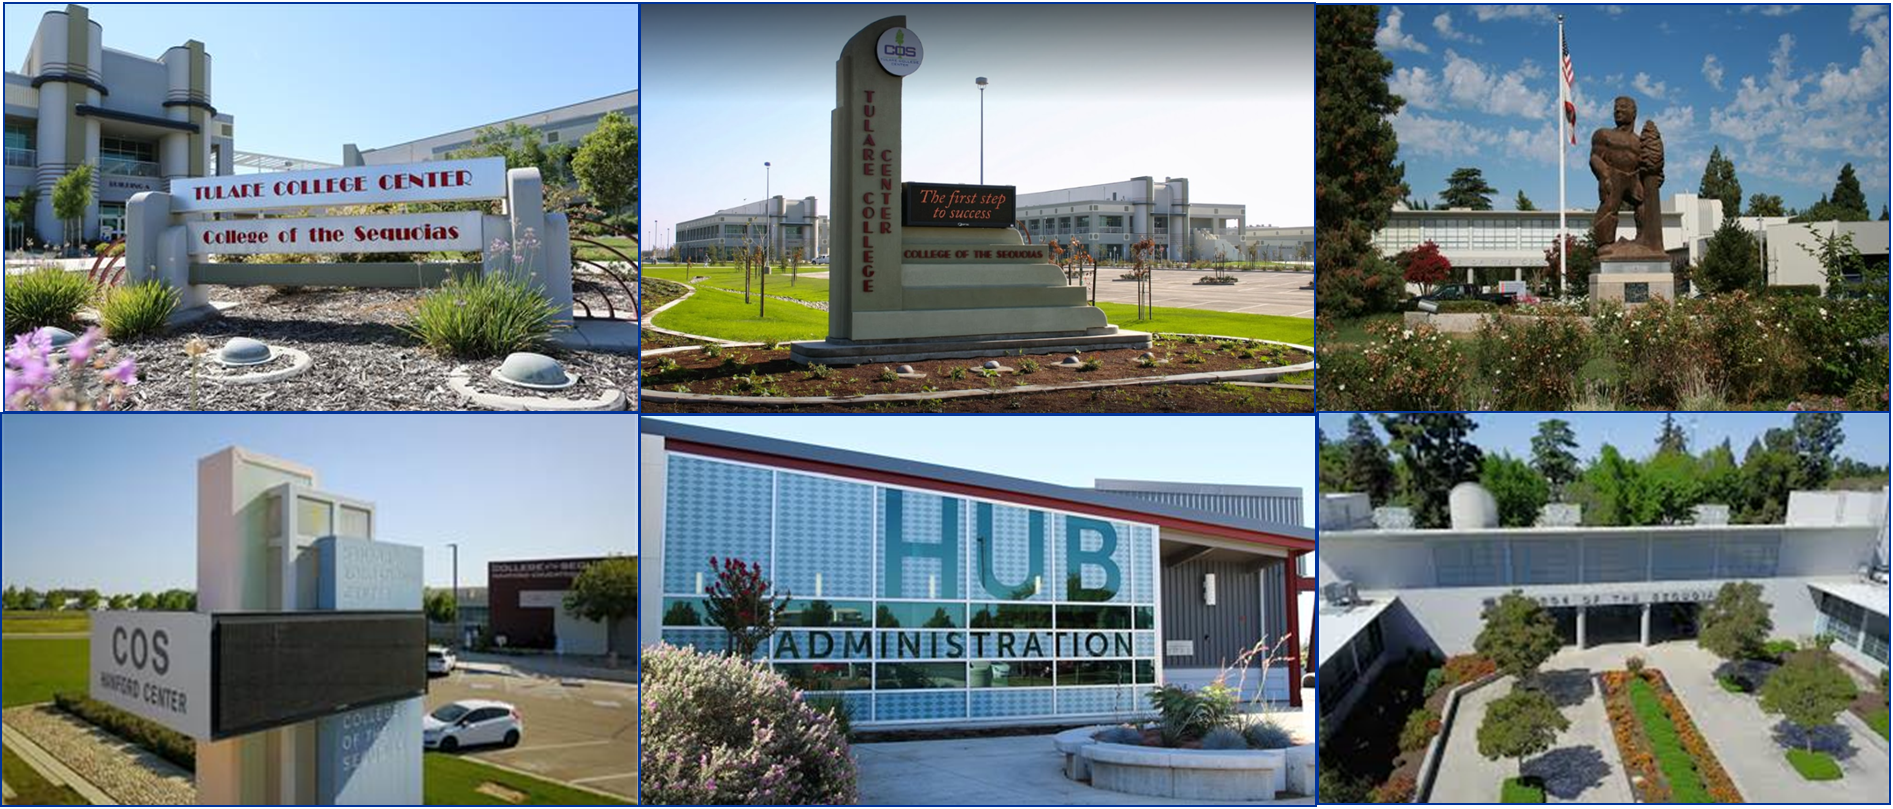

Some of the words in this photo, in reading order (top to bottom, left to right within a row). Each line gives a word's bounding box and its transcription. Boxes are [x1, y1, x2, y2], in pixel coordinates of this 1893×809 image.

[884, 44, 916, 58] COS
[863, 90, 876, 176] TULARE
[193, 182, 266, 200] TULARE
[273, 176, 368, 197] COLLEGE
[378, 170, 473, 191] CENTER
[879, 149, 892, 234] CENTER
[920, 189, 946, 204] The
[945, 190, 977, 209] first
[980, 193, 1006, 210] step
[933, 207, 946, 219] to
[949, 208, 992, 219] success
[203, 230, 269, 245] College
[278, 227, 298, 244] of
[309, 227, 344, 243] the
[354, 223, 460, 243] Sequoias
[862, 192, 875, 292] COLLEGE
[904, 249, 951, 259] COLLEGE
[955, 249, 969, 259] OF
[973, 249, 992, 259] THE
[996, 249, 1043, 259] SEQUOIAS
[885, 487, 1121, 603] HUB
[1652, 590, 1714, 602] SEQUOIA
[113, 625, 170, 676] COS
[774, 629, 1133, 660] ADMINISTRATION
[143, 682, 188, 715] CENTER
